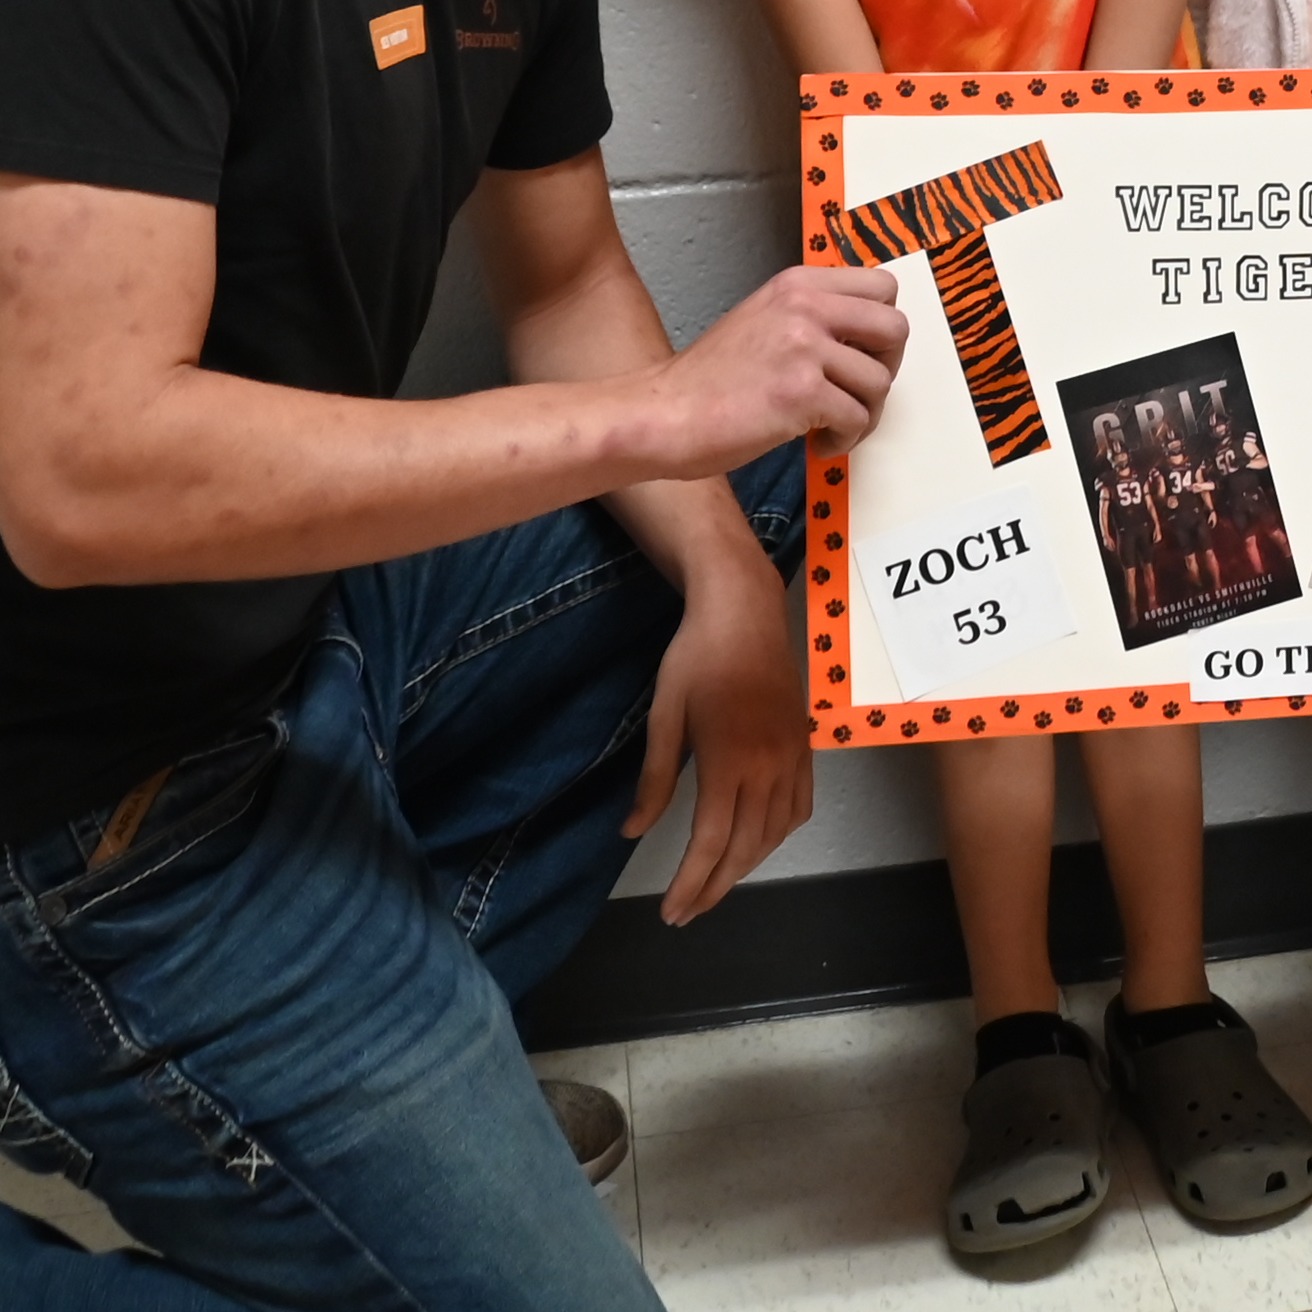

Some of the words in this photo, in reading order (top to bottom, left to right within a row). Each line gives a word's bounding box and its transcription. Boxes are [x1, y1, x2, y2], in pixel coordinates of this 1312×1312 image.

[1116, 481, 1142, 507] 53
[885, 518, 1031, 599] ZOCH
[952, 600, 1007, 645] 53
[1204, 648, 1264, 680] GO
